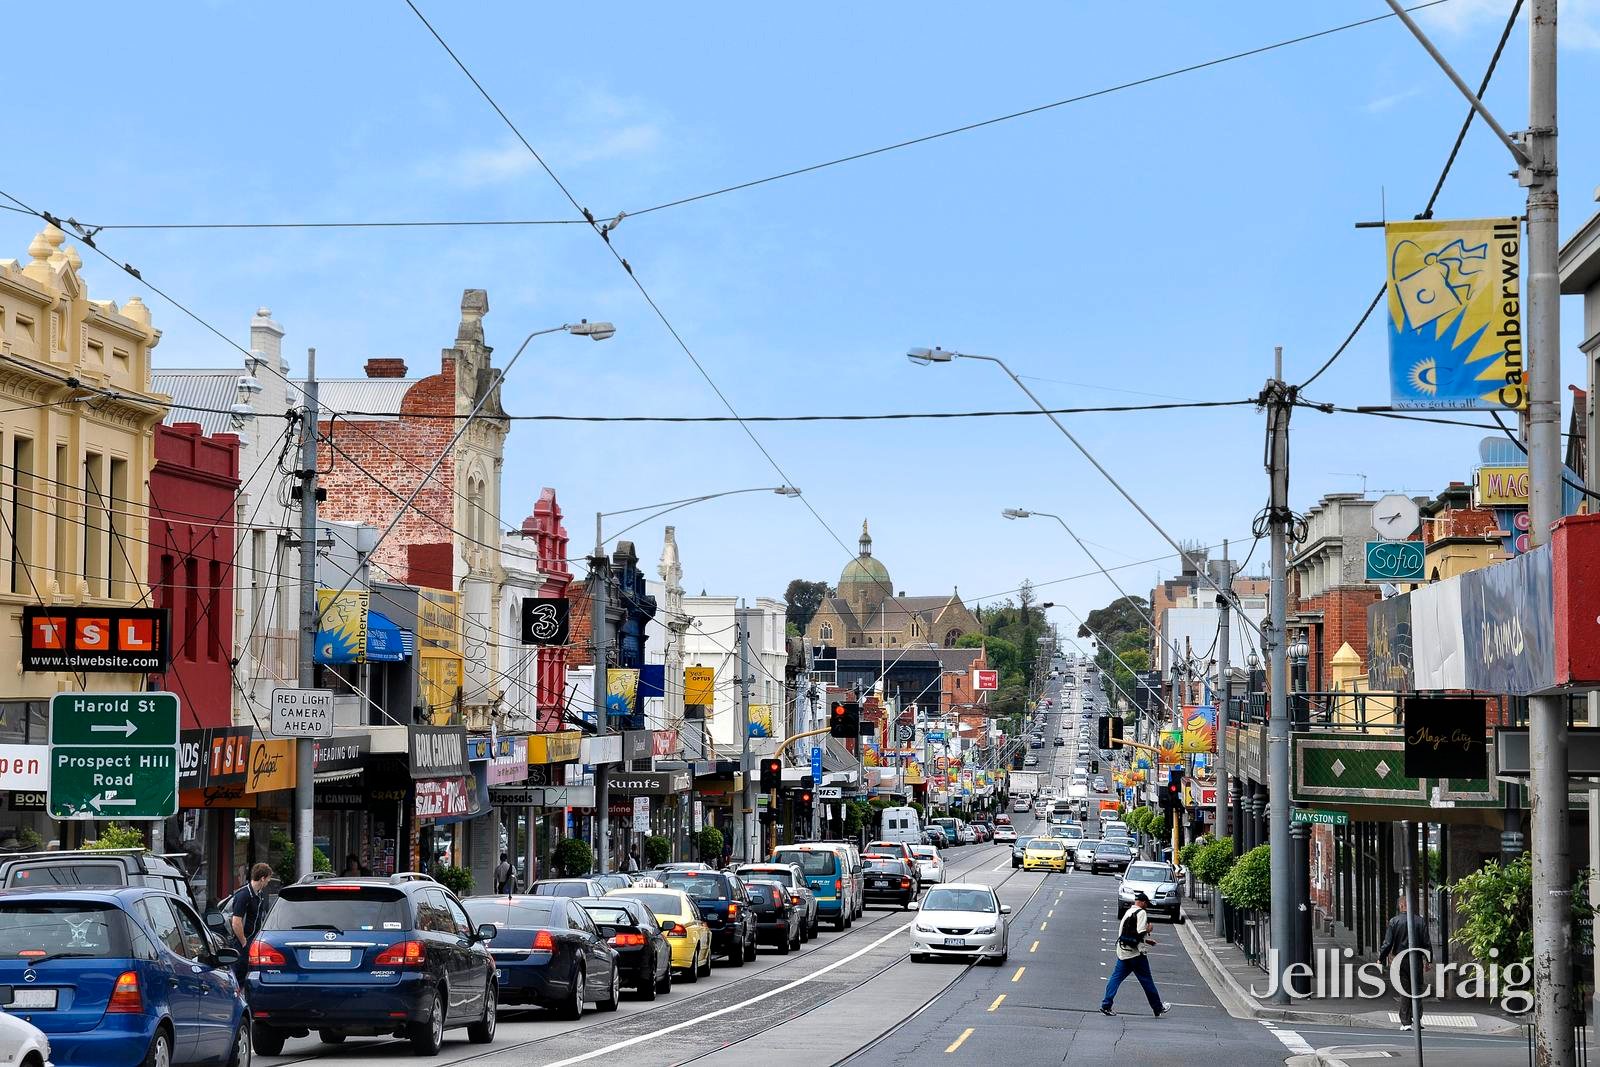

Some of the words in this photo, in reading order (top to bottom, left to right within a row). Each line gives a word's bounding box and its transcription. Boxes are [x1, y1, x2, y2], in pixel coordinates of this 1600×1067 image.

[1429, 401, 1444, 410] got
[1449, 400, 1457, 409] it
[1375, 546, 1419, 576] Sofia
[31, 656, 159, 667] www.tslwebsite.com
[277, 694, 297, 704] RED
[302, 695, 330, 705] LIGHT
[74, 700, 129, 712] Harold
[138, 700, 156, 712] St
[280, 708, 326, 718] CAMERA
[284, 721, 322, 731] AHEAD
[1408, 726, 1449, 750] Magic
[1451, 729, 1483, 751] City
[213, 744, 245, 769] TSL
[347, 745, 360, 759] OUT
[58, 755, 131, 770] Prospect
[140, 755, 169, 767] Hill
[252, 743, 284, 790] Gidget
[93, 773, 133, 786] Road
[607, 779, 660, 789] Kumfs
[325, 794, 362, 804] CANYON
[489, 791, 533, 804] Disposals
[415, 795, 442, 815] SALE
[1295, 813, 1334, 823] MAYSTON
[1336, 816, 1347, 824] ST
